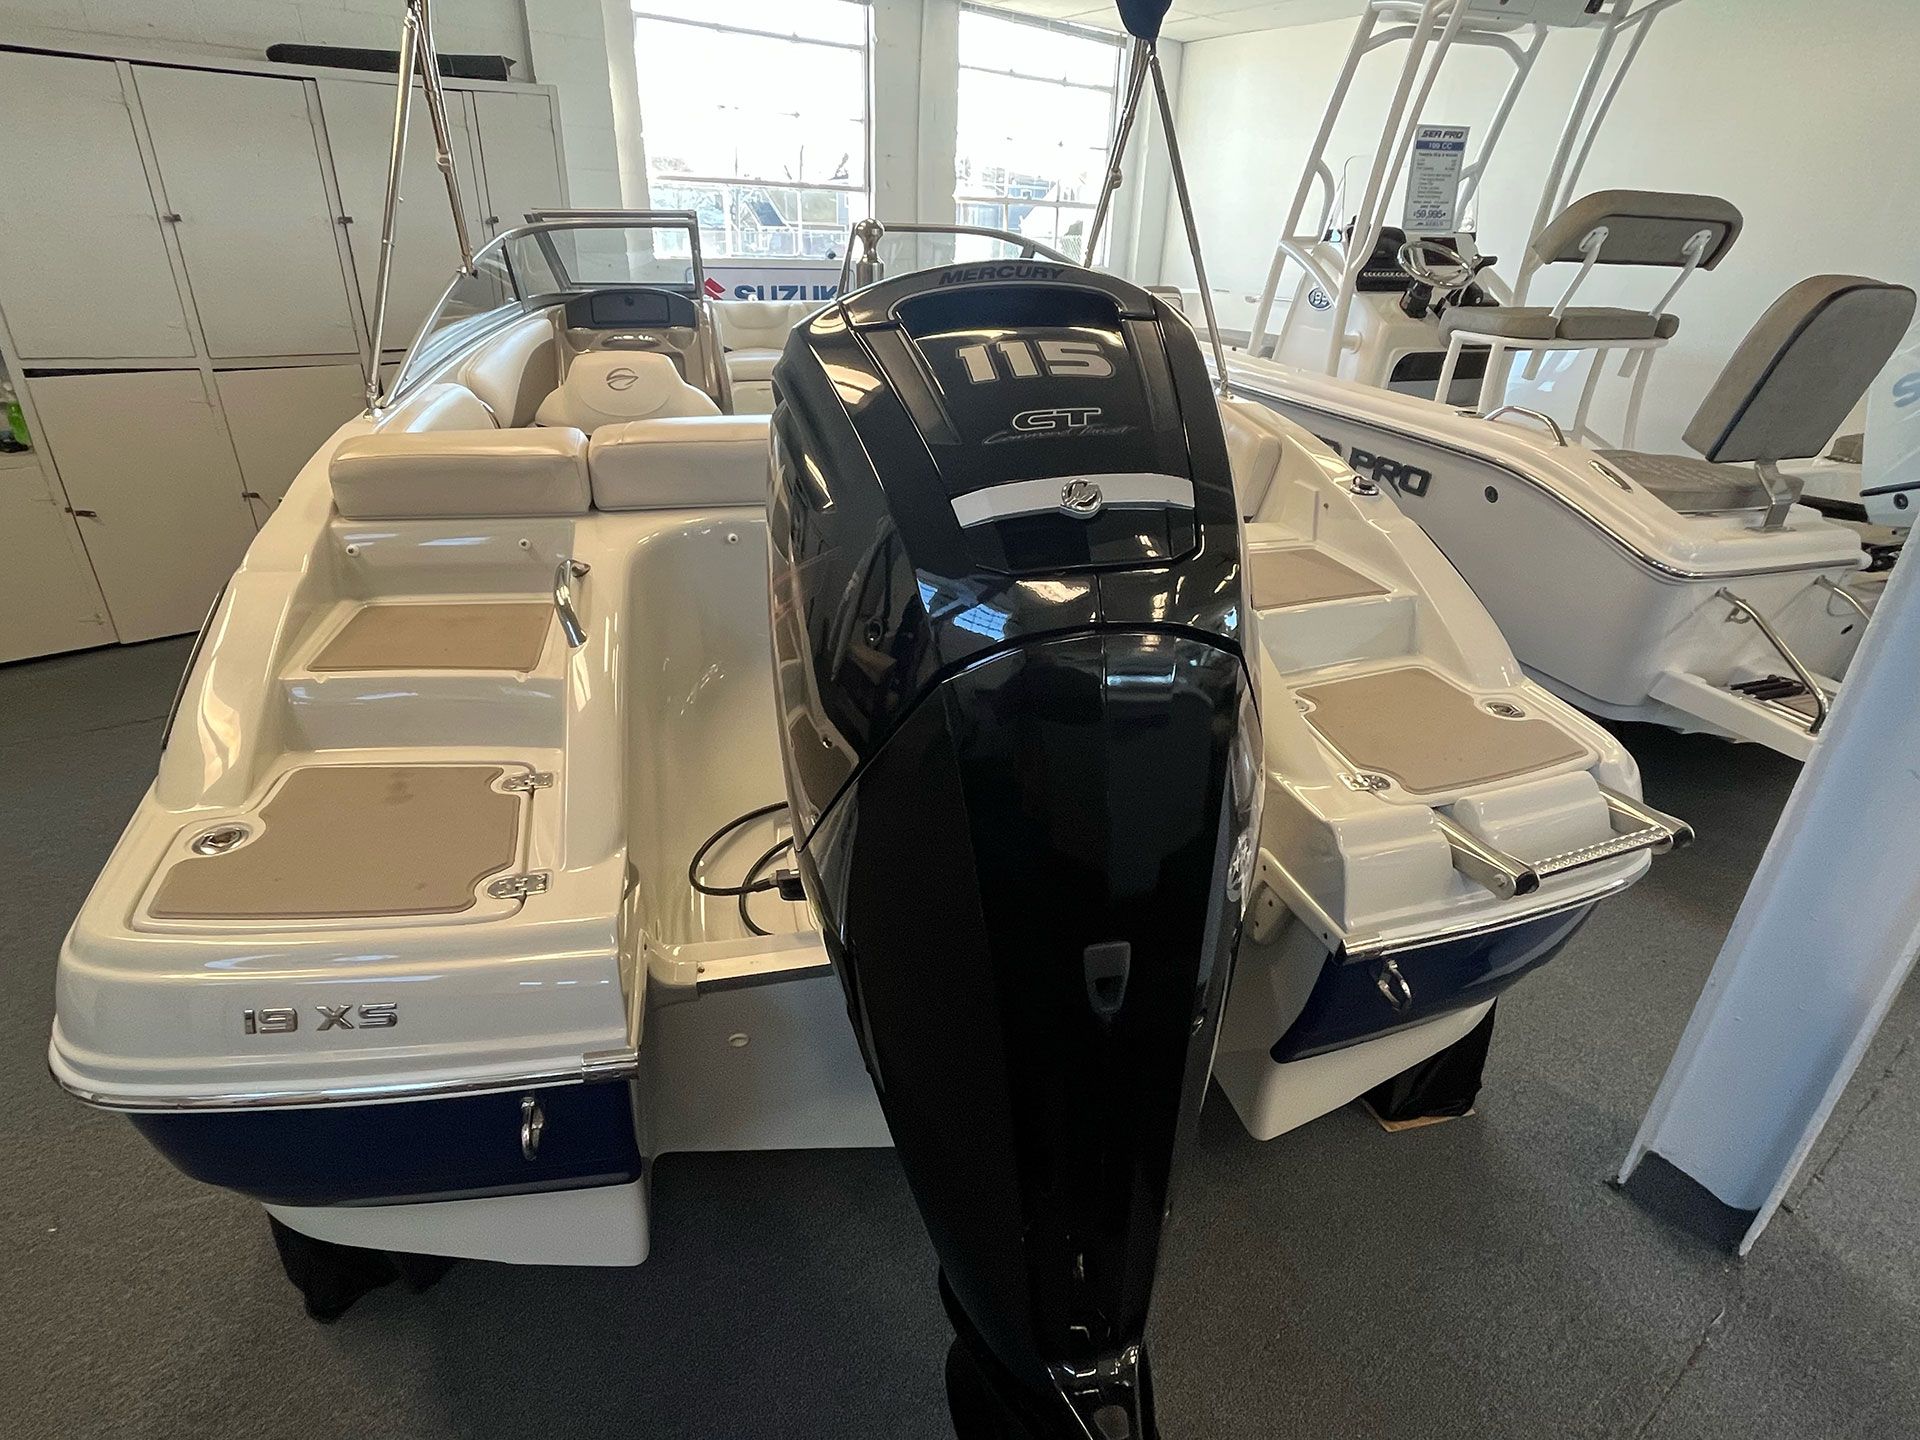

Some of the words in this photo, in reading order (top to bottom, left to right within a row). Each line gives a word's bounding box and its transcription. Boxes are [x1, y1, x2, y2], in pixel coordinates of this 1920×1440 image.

[1421, 129, 1443, 138] SEA
[1442, 130, 1464, 139] PRO
[1441, 142, 1453, 150] CC
[938, 264, 1064, 286] MERCURY
[734, 284, 840, 301] SUZUK
[956, 339, 1116, 384] 115
[1349, 447, 1432, 498] PRO
[244, 1006, 298, 1035] 19
[315, 1002, 398, 1032] XS
